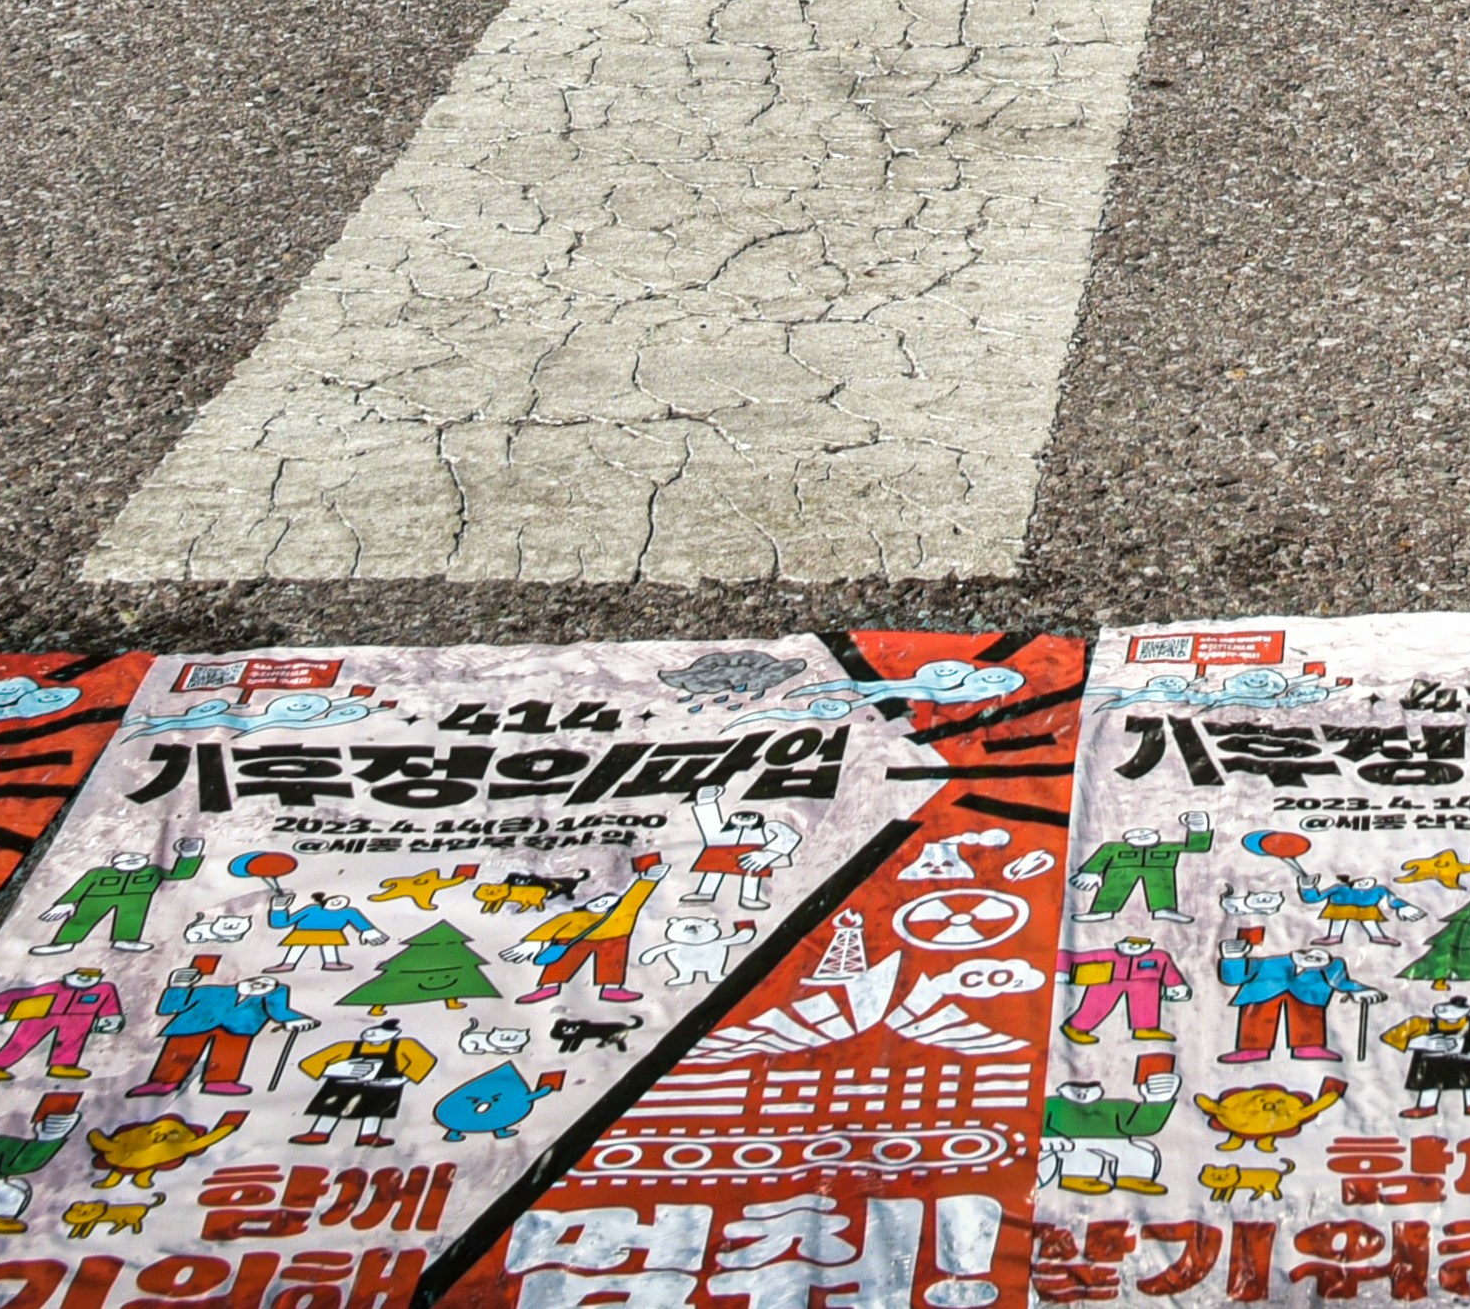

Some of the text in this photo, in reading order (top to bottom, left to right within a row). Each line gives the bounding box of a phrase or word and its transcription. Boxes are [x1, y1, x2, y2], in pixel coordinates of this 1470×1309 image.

[437, 701, 622, 735] 414
[1273, 795, 1384, 811] 2023.
[1388, 796, 1425, 810] 4.
[272, 814, 669, 834] 2023. 4. 14(금) 14:00
[959, 968, 1024, 989] CO2
[197, 1163, 457, 1240] 함께
[504, 1192, 1003, 1309] 멈춰!
